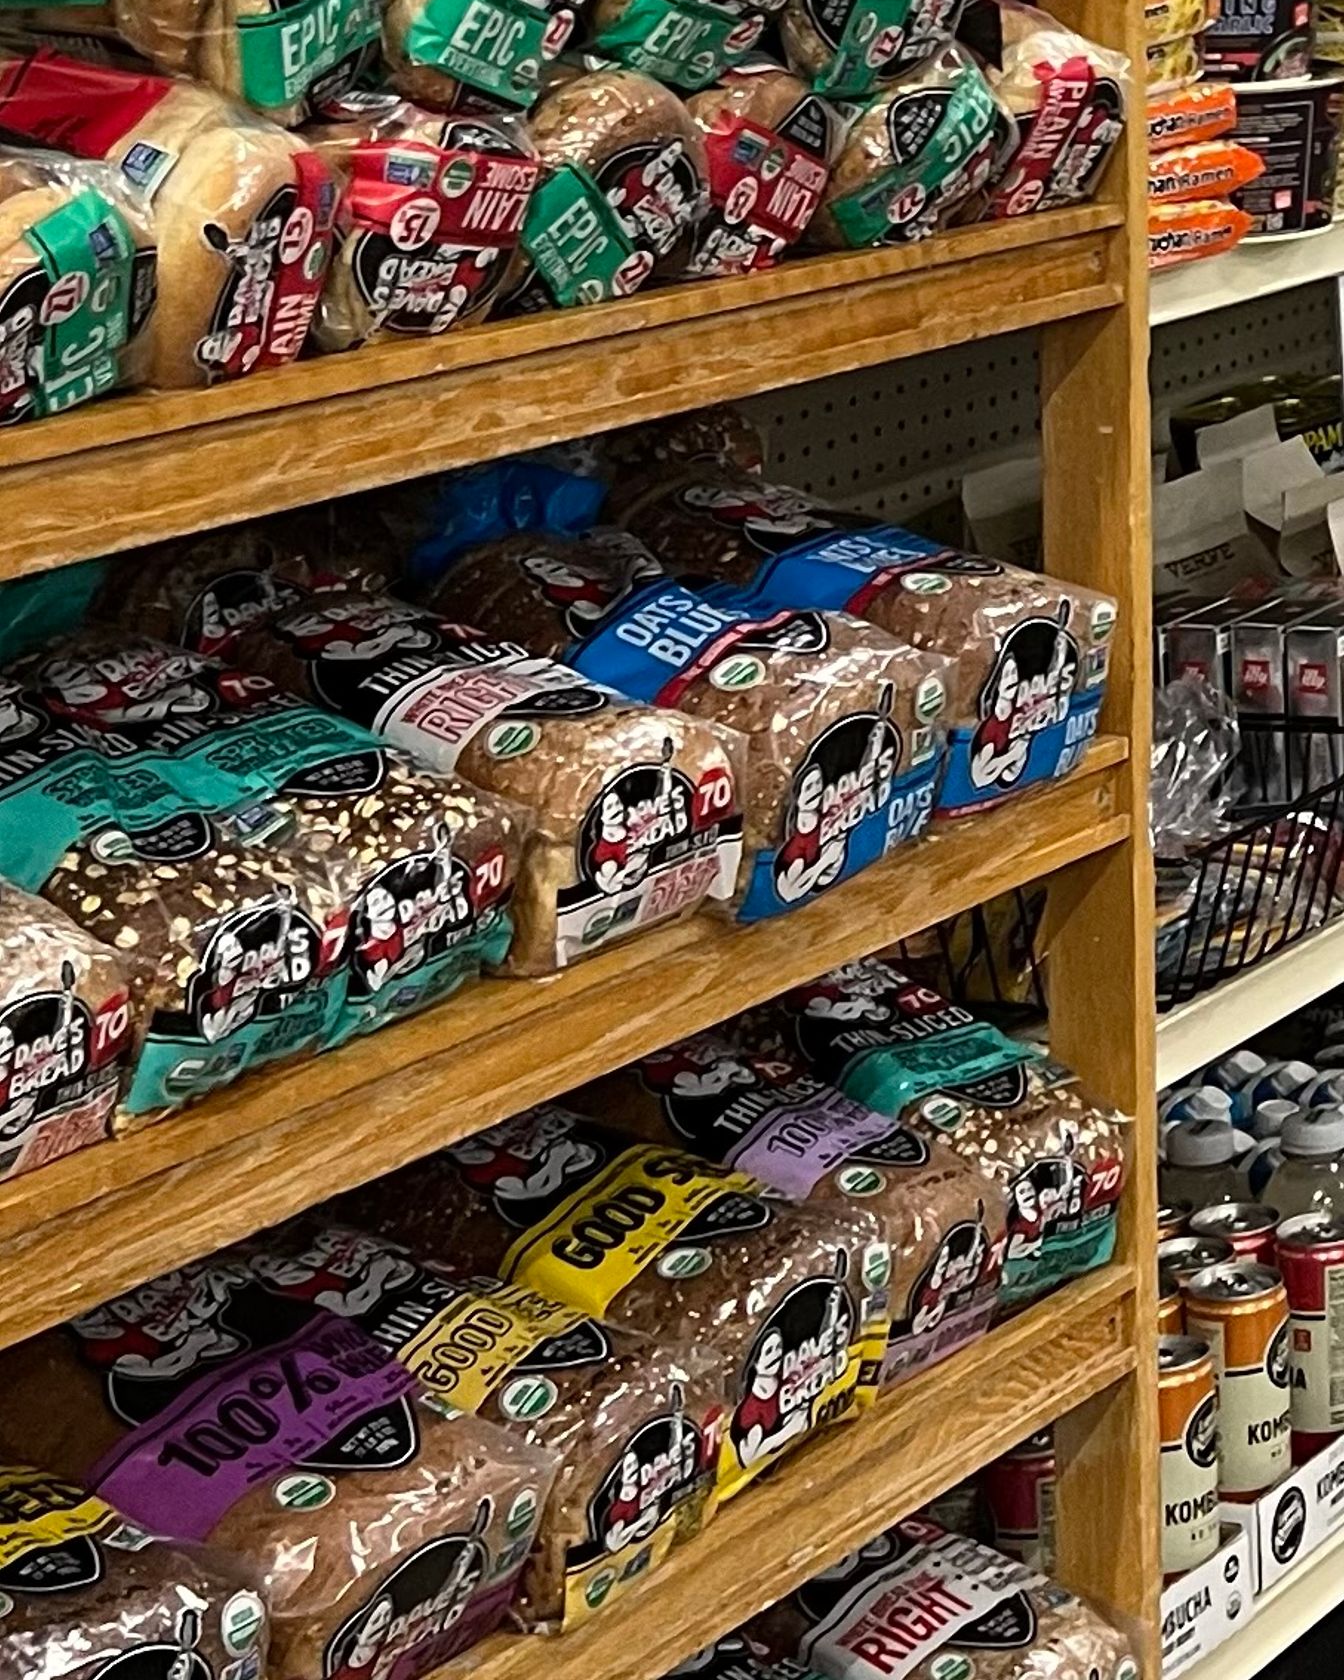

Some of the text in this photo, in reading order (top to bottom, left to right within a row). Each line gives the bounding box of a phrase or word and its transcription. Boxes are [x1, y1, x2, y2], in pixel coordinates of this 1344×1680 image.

[452, 1, 528, 64] EPIC
[549, 197, 610, 273] EPIC
[1164, 542, 1234, 578] VERVE
[616, 594, 694, 647] OATS
[699, 779, 732, 815] 70
[474, 856, 504, 894] 70
[94, 1009, 130, 1052] 70
[1092, 1165, 1120, 1197] 70
[551, 1183, 666, 1270] GOOD
[158, 1355, 338, 1476] 100%
[851, 1578, 974, 1675] RIGHT
